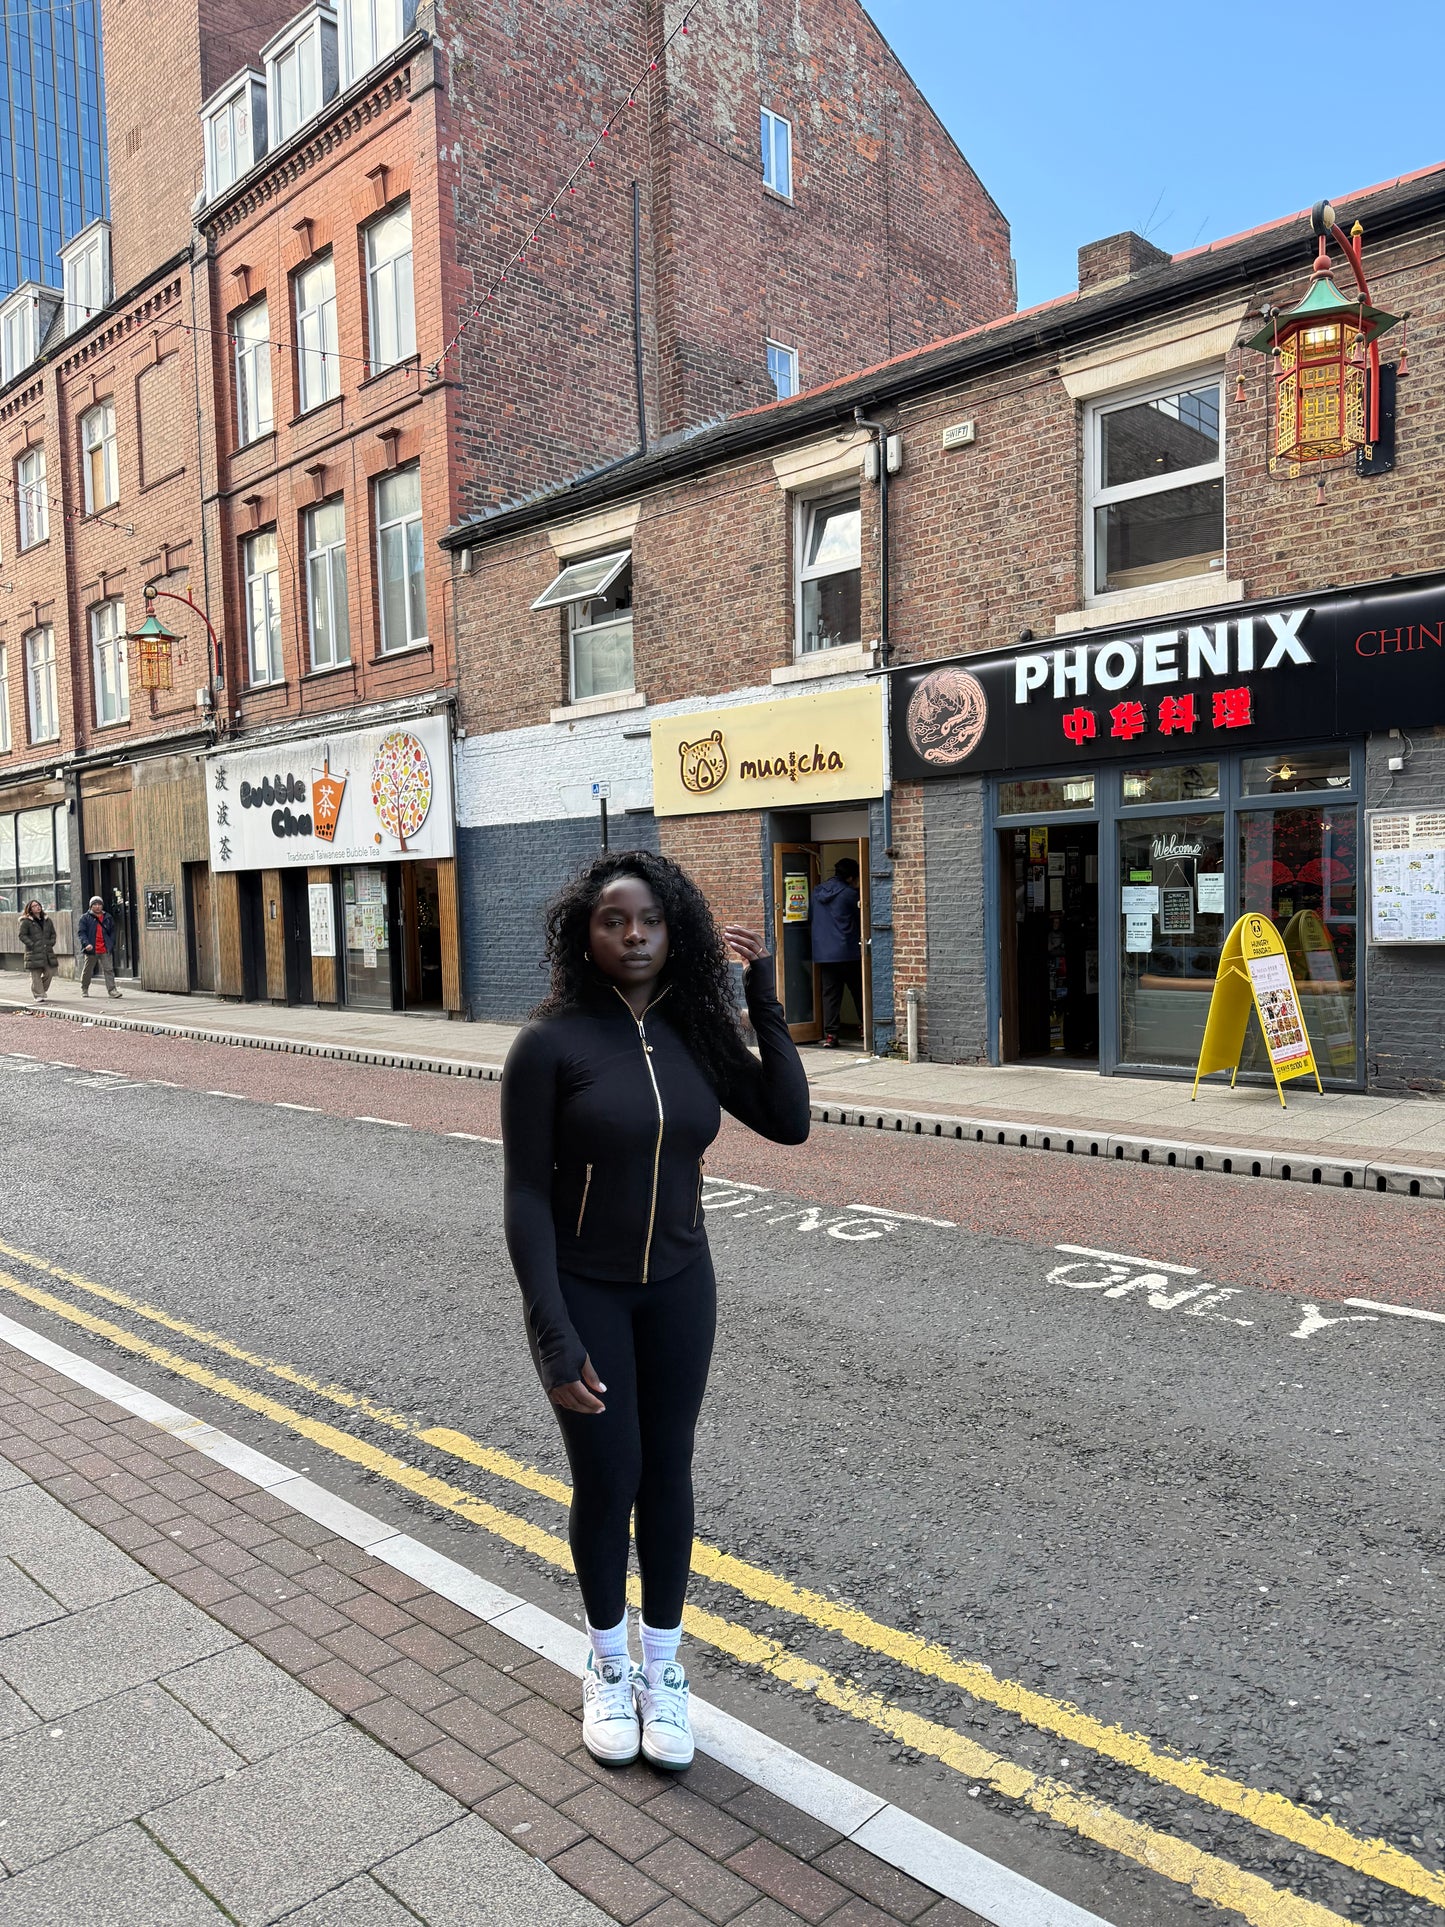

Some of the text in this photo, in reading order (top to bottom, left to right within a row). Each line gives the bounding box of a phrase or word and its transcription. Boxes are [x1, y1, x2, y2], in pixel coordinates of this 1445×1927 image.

[946, 427, 966, 440] SWIFT
[1355, 621, 1445, 657] CHIN
[1015, 607, 1315, 704] PHOENIX
[1062, 686, 1254, 746] 中华料理
[240, 772, 306, 809] Bubble
[317, 784, 336, 819] 茶
[271, 807, 313, 838] Cha
[287, 846, 380, 861] Traditional Taiwanese Bubble Tea
[1152, 834, 1202, 857] Welcome
[1251, 939, 1269, 948] HUNGRY
[1253, 947, 1268, 956] PANDA
